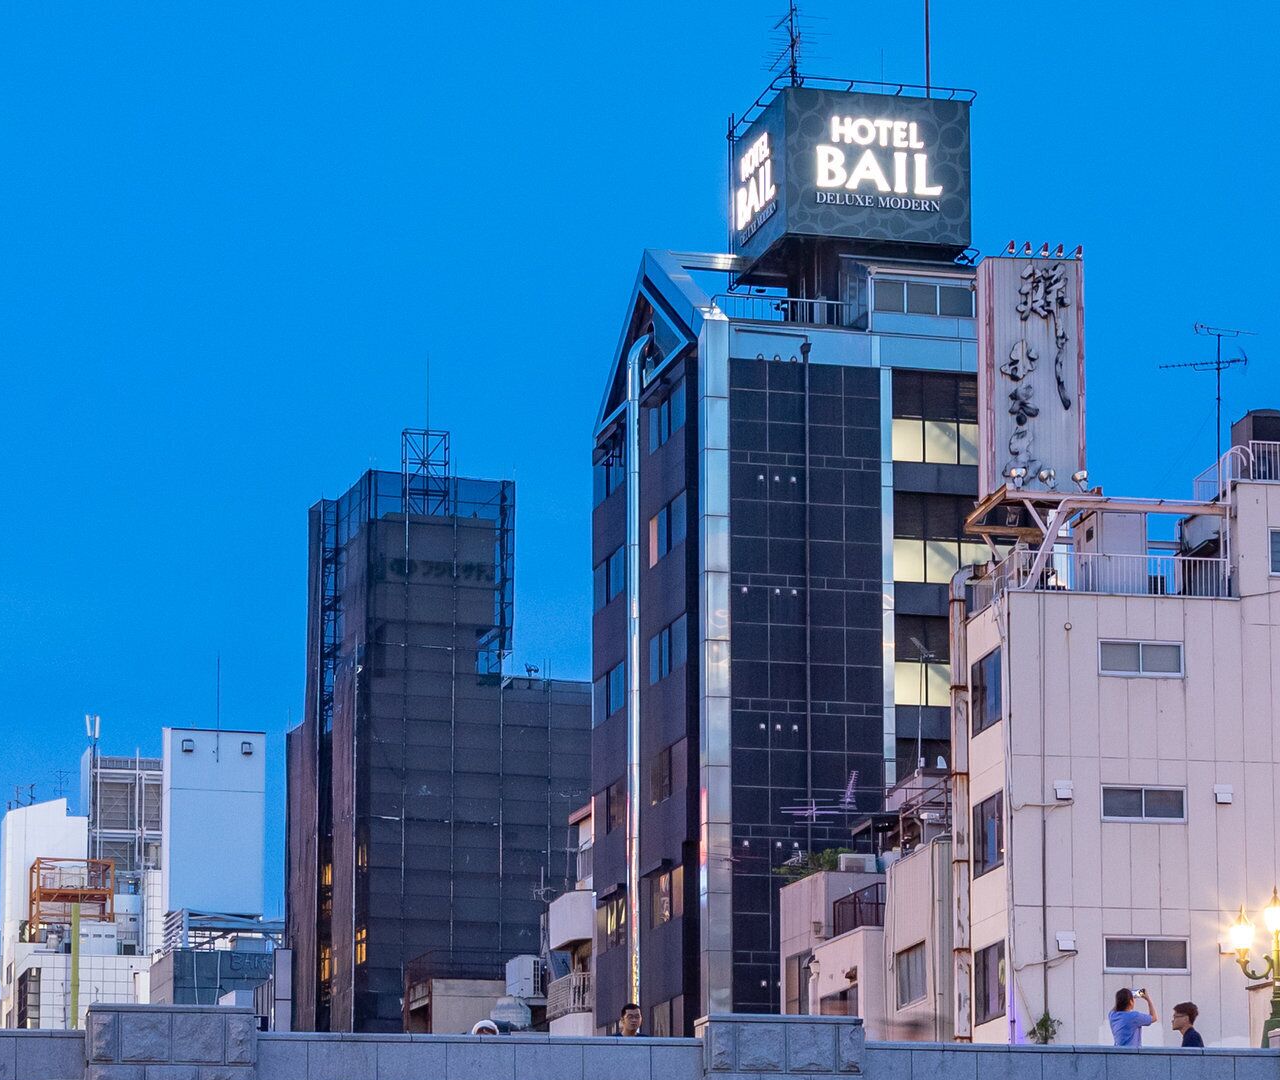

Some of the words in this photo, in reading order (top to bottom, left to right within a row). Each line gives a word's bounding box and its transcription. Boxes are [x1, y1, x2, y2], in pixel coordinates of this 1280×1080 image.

[741, 132, 770, 182] HOTEL
[831, 116, 924, 149] HOTEL
[737, 158, 776, 231] BAIL
[816, 145, 943, 195] BAIL
[816, 192, 874, 207] DELUXE
[878, 197, 940, 212] MODERN
